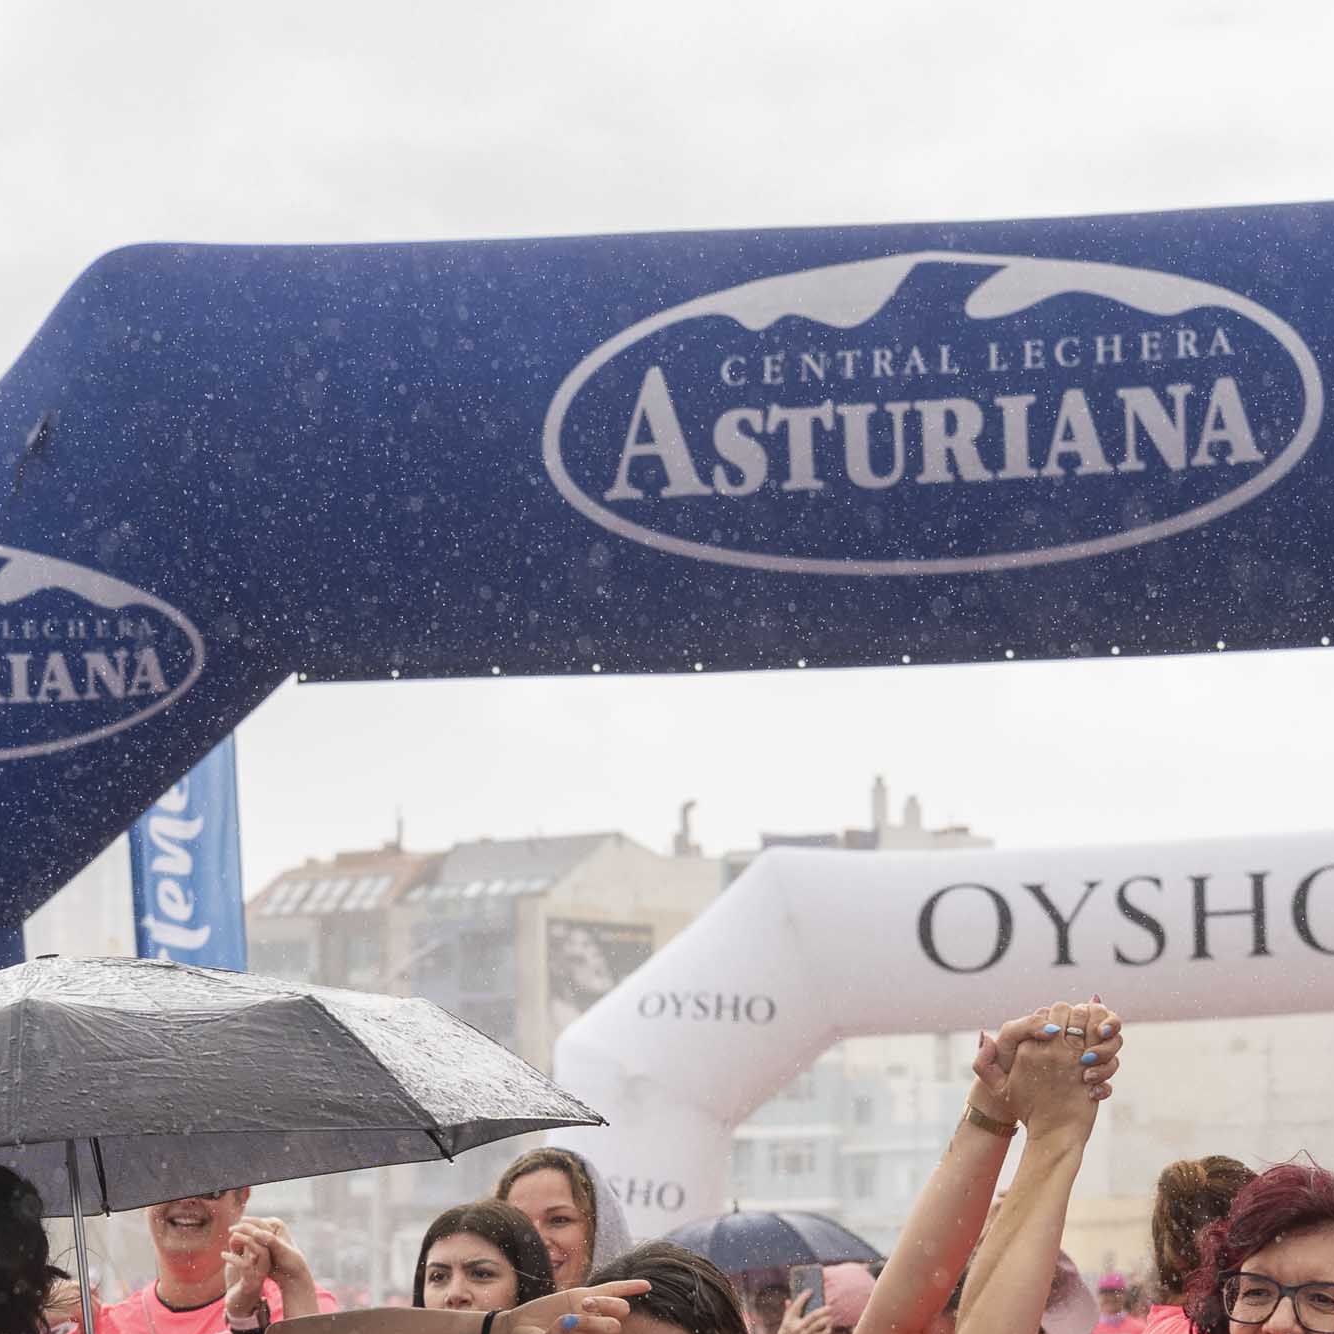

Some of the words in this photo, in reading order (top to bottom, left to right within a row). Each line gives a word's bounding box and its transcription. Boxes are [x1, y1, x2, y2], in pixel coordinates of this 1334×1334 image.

[720, 344, 962, 387] CENTRAL
[988, 327, 1237, 372] LECHERA
[603, 366, 1265, 502] ASTURIANA
[2, 618, 155, 641] LECHERA
[637, 989, 777, 1025] OYSHO
